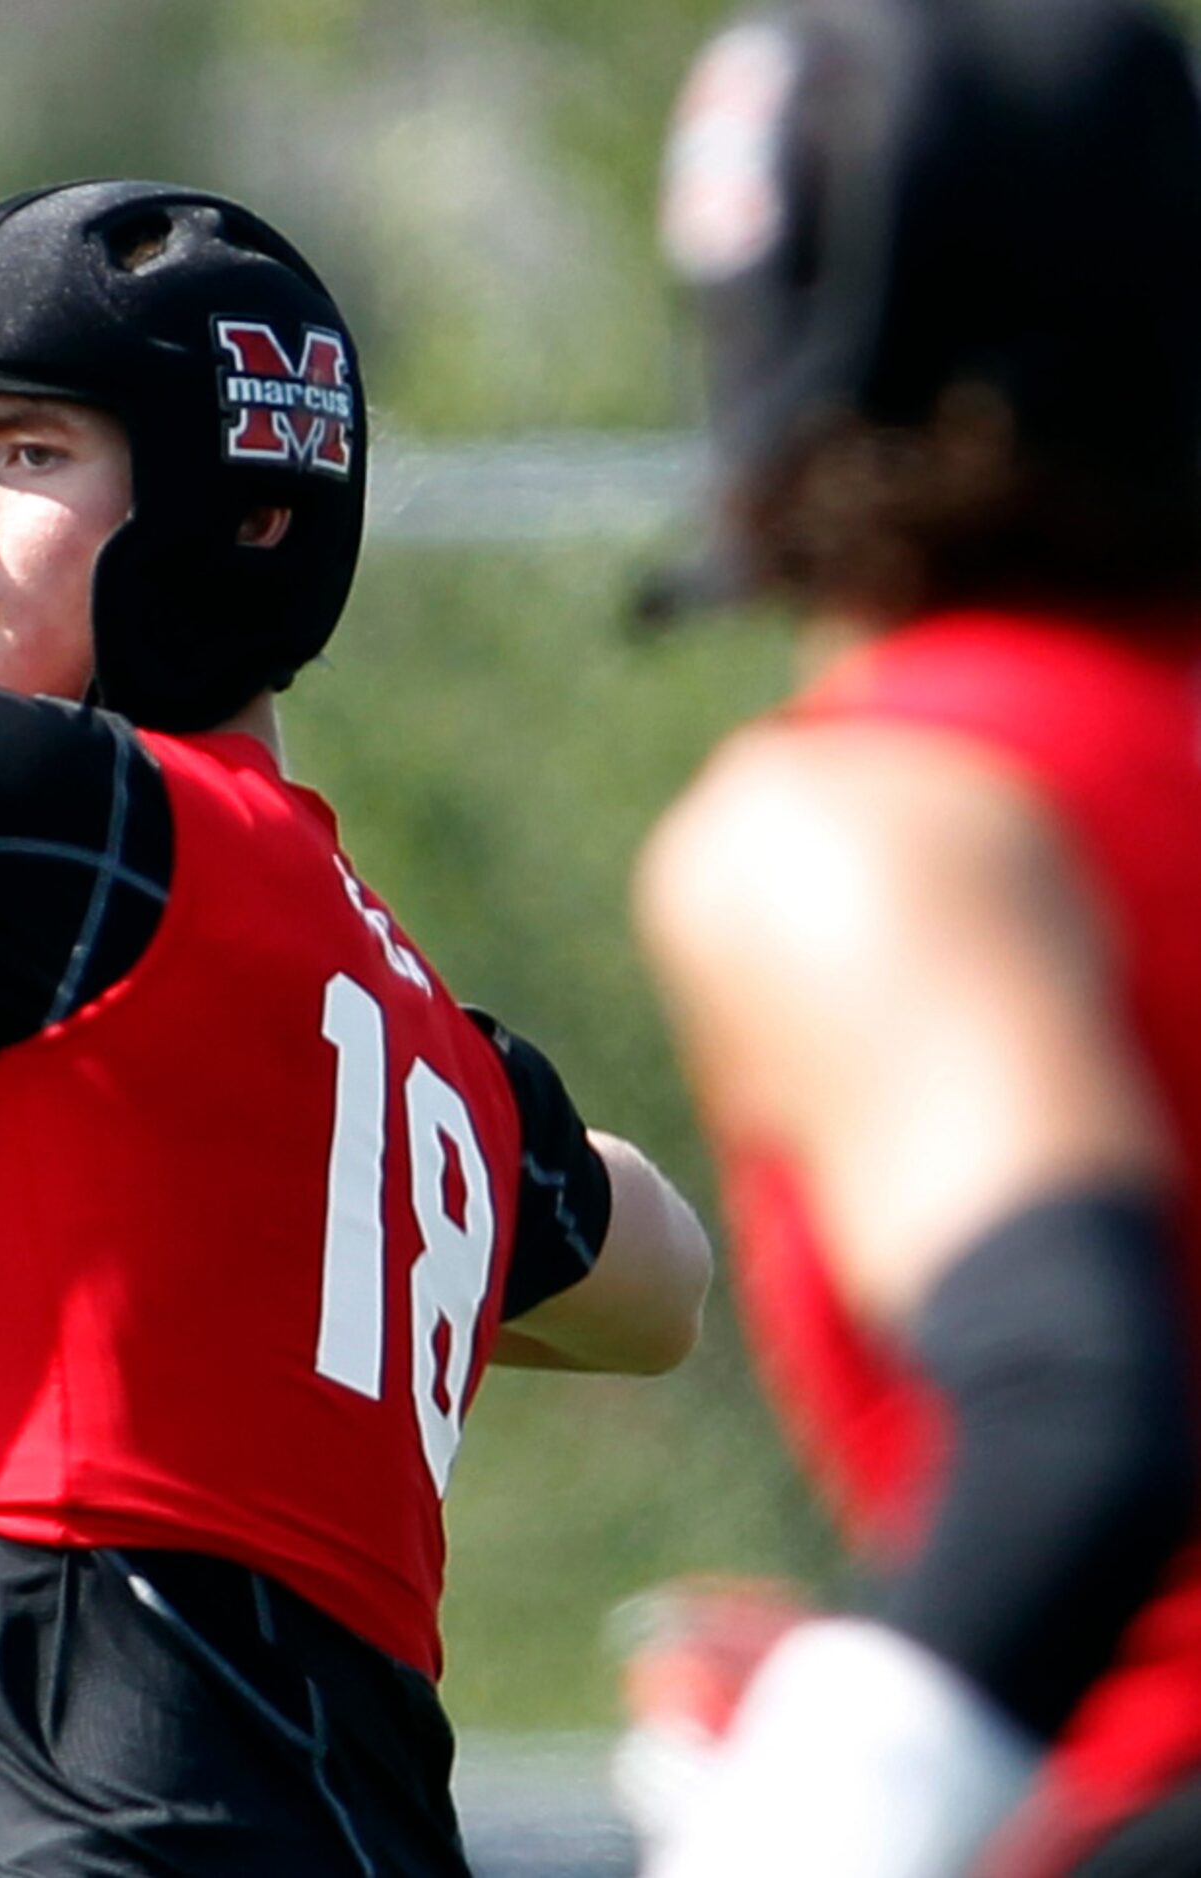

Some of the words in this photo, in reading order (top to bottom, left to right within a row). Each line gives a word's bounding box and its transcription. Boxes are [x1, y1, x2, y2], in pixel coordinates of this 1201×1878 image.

[216, 321, 350, 473] M
[227, 377, 350, 418] marcus
[315, 971, 494, 1500] 18
